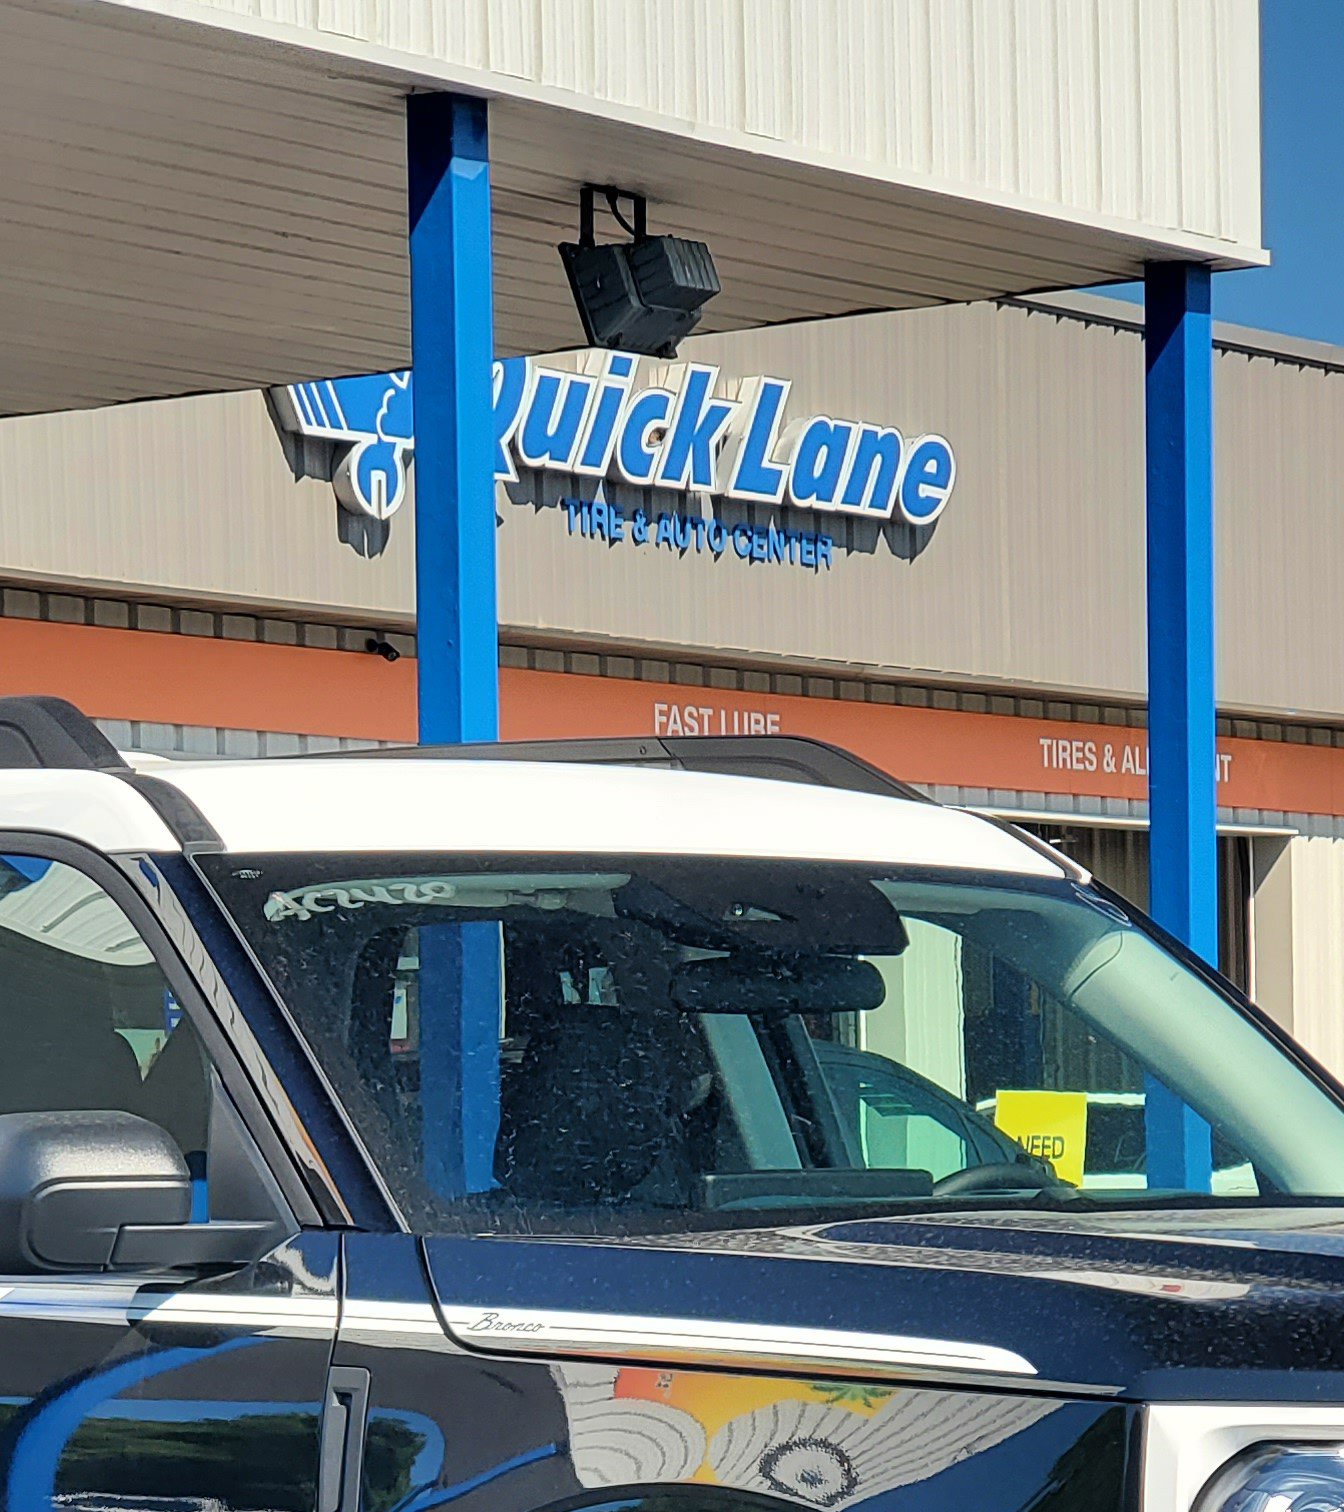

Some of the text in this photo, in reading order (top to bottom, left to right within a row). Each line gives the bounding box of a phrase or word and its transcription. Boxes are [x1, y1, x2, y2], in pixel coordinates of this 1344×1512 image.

[728, 375, 956, 525] Lane
[562, 498, 833, 570] TIRE & AUTO CENTER
[654, 703, 713, 736] FAST
[1039, 738, 1097, 772] TIRES
[1103, 744, 1117, 773] &
[1017, 1134, 1064, 1160] NEED
[467, 1312, 545, 1333] Bronco
